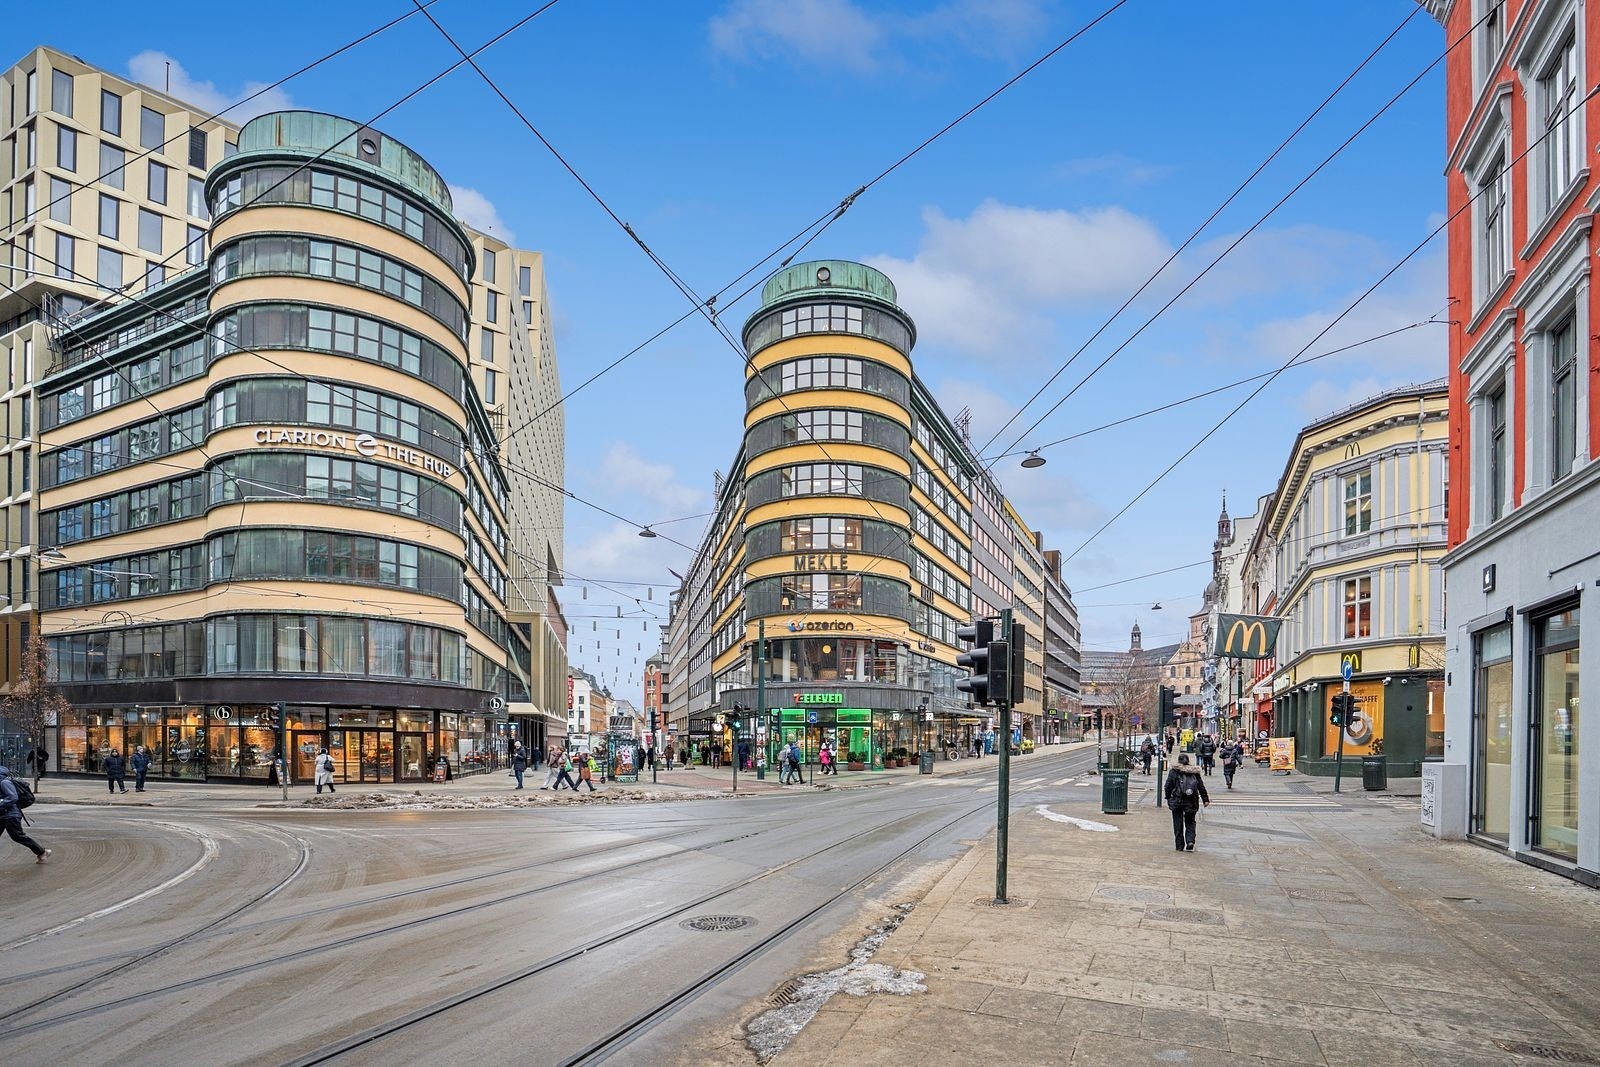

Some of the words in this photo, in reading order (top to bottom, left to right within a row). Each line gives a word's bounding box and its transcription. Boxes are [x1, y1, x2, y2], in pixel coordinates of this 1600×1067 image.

[254, 428, 346, 449] CLARION
[384, 443, 418, 466] THE
[422, 455, 451, 478] HUB
[794, 554, 848, 570] MEKLE
[806, 619, 854, 631] azerion
